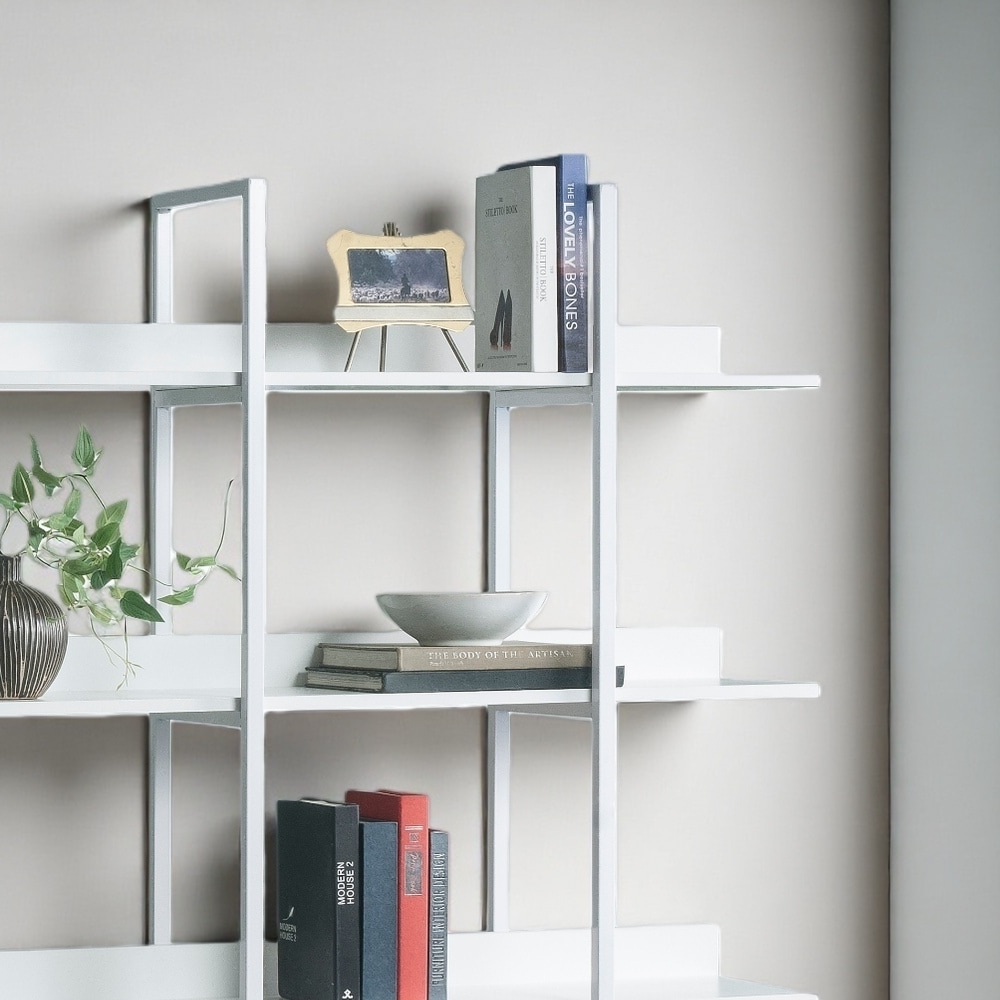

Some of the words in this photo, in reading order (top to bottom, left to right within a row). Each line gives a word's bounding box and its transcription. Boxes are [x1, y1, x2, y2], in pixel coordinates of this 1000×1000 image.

[562, 202, 576, 268] LOVELY
[539, 279, 548, 302] BOOK
[565, 273, 578, 330] BONES
[428, 651, 448, 660] THE
[453, 651, 481, 660] BODY
[484, 651, 498, 659] OF
[502, 650, 523, 658] TH
[336, 862, 346, 905] MODERN
[346, 870, 354, 904] HOUSE
